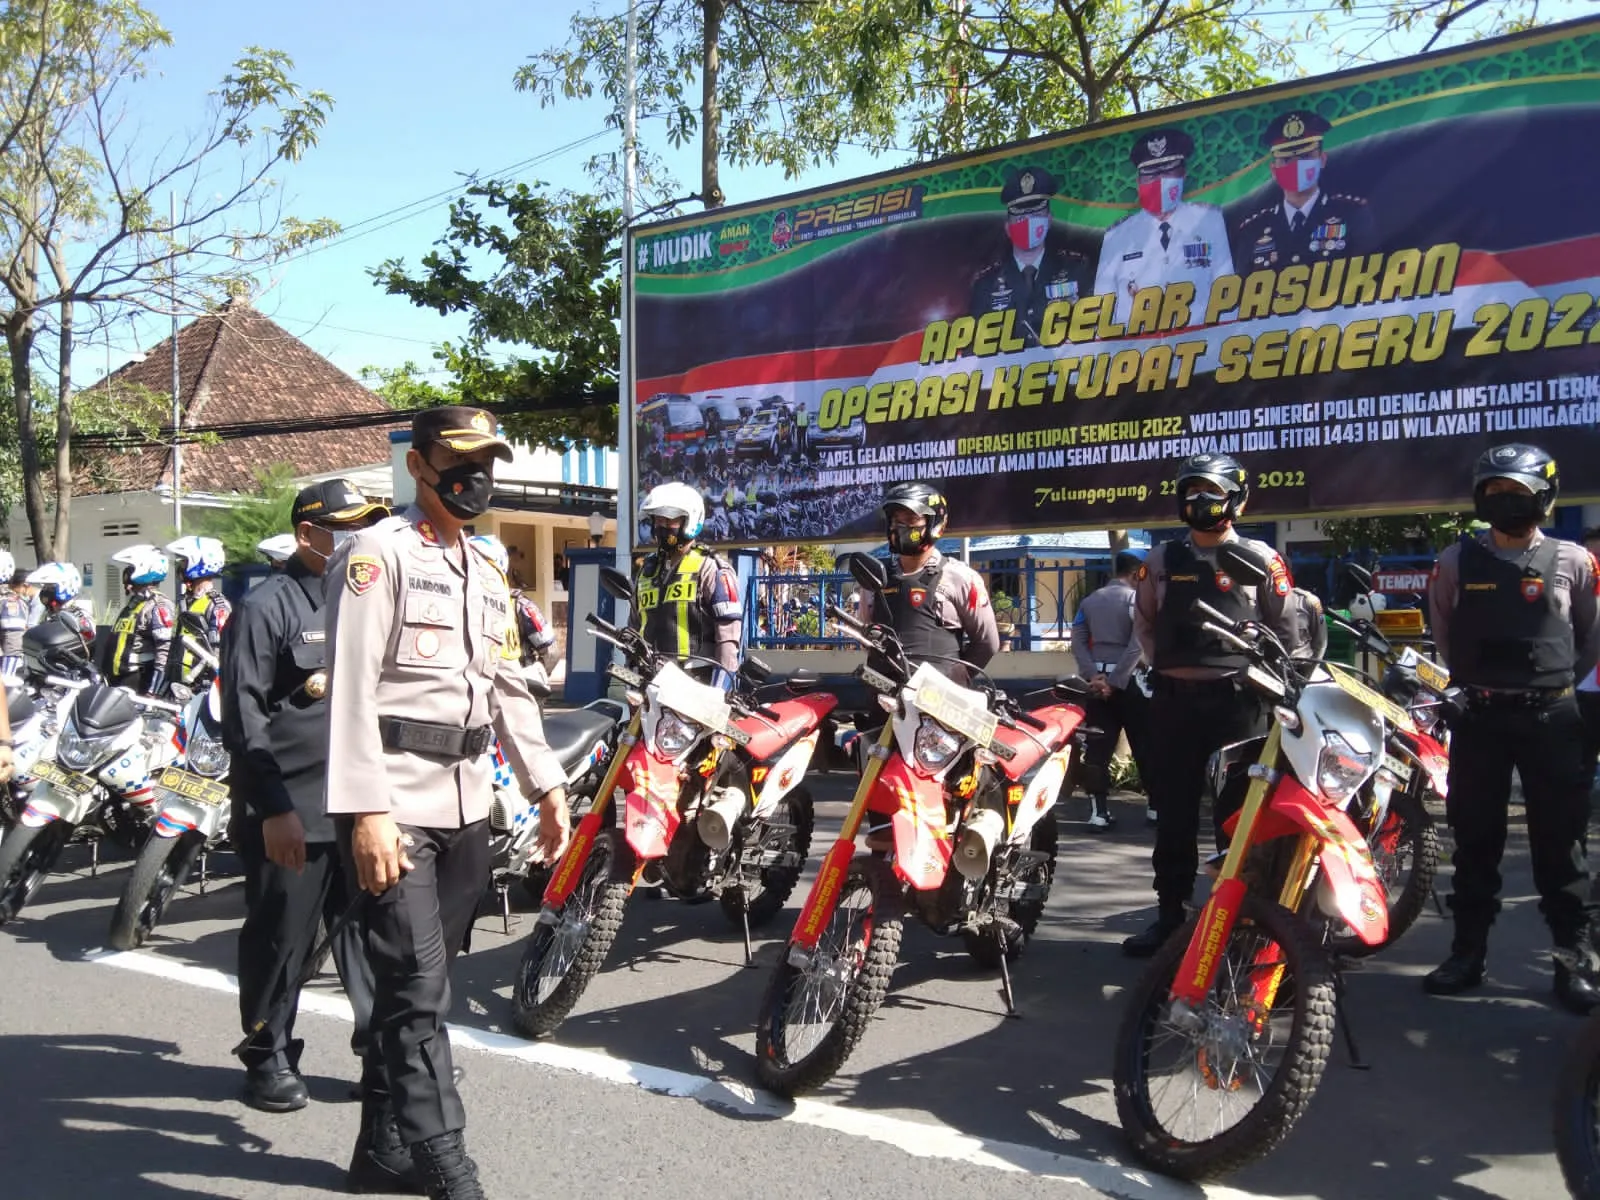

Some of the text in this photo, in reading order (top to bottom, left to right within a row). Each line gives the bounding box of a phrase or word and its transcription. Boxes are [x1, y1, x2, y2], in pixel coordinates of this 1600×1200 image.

[794, 187, 913, 231] PRESISI
[721, 223, 750, 240] AMAN
[919, 242, 1461, 365] APEL GELAR PASUKAN
[818, 292, 1600, 430] OPERASI KETUPAT SEMERU 202
[856, 463, 915, 484] MENJAMIN
[917, 458, 995, 479] MASYARAKAT
[998, 453, 1035, 472] AMAN
[1038, 451, 1064, 469] DAN
[1067, 445, 1107, 466] SEHAT
[1111, 441, 1159, 463] DALAM
[1162, 436, 1239, 459] PERAYAAN
[1243, 431, 1277, 452] IDUL
[1281, 426, 1319, 450] FITRI
[1324, 422, 1364, 445] 1443
[1367, 421, 1378, 442] H
[1382, 419, 1399, 441] DI
[1403, 412, 1480, 439] WILAYAH
[1485, 402, 1600, 432] TULUNGAGU
[857, 445, 895, 465] GELAR
[898, 439, 955, 461] PASUKAN
[958, 436, 1014, 456] OPERASI
[1016, 426, 1078, 448] KETUPAT
[1080, 420, 1139, 443] SEMERU
[1143, 416, 1186, 438] 2022,
[1190, 409, 1250, 432] WUJUD
[1254, 400, 1319, 427] SINERGI
[1324, 397, 1375, 421] POLRI
[1379, 389, 1452, 416] DENGAN
[1456, 380, 1542, 409] INSTANSI
[1034, 484, 1153, 507] Tulungagung,
[1258, 470, 1305, 489] 2022
[1377, 573, 1430, 590] TEMPAT
[1008, 788, 1023, 802] 15
